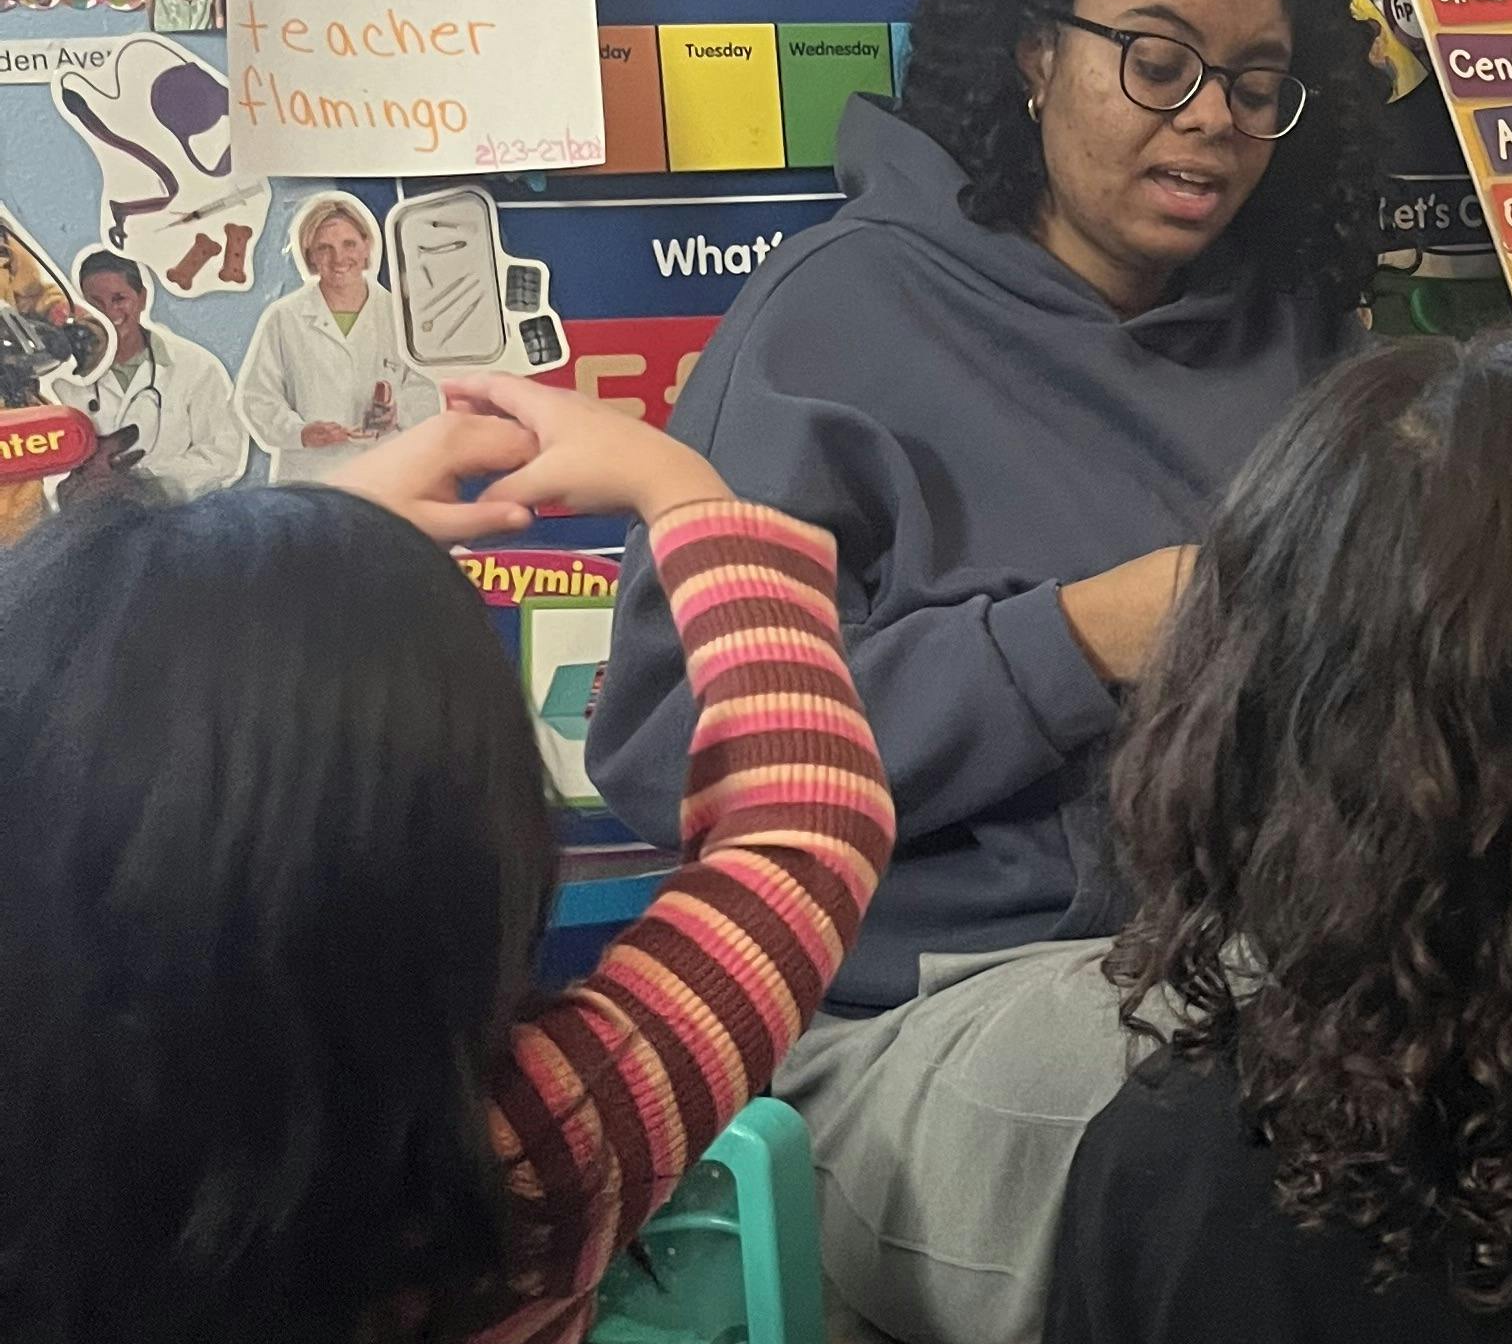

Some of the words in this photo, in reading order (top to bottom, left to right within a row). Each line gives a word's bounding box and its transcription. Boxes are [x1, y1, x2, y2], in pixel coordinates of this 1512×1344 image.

[238, 0, 496, 57] teacher
[56, 48, 112, 69] Ave
[685, 43, 752, 61] Tuesday
[789, 41, 880, 59] Wednesday
[238, 65, 468, 153] flamingo
